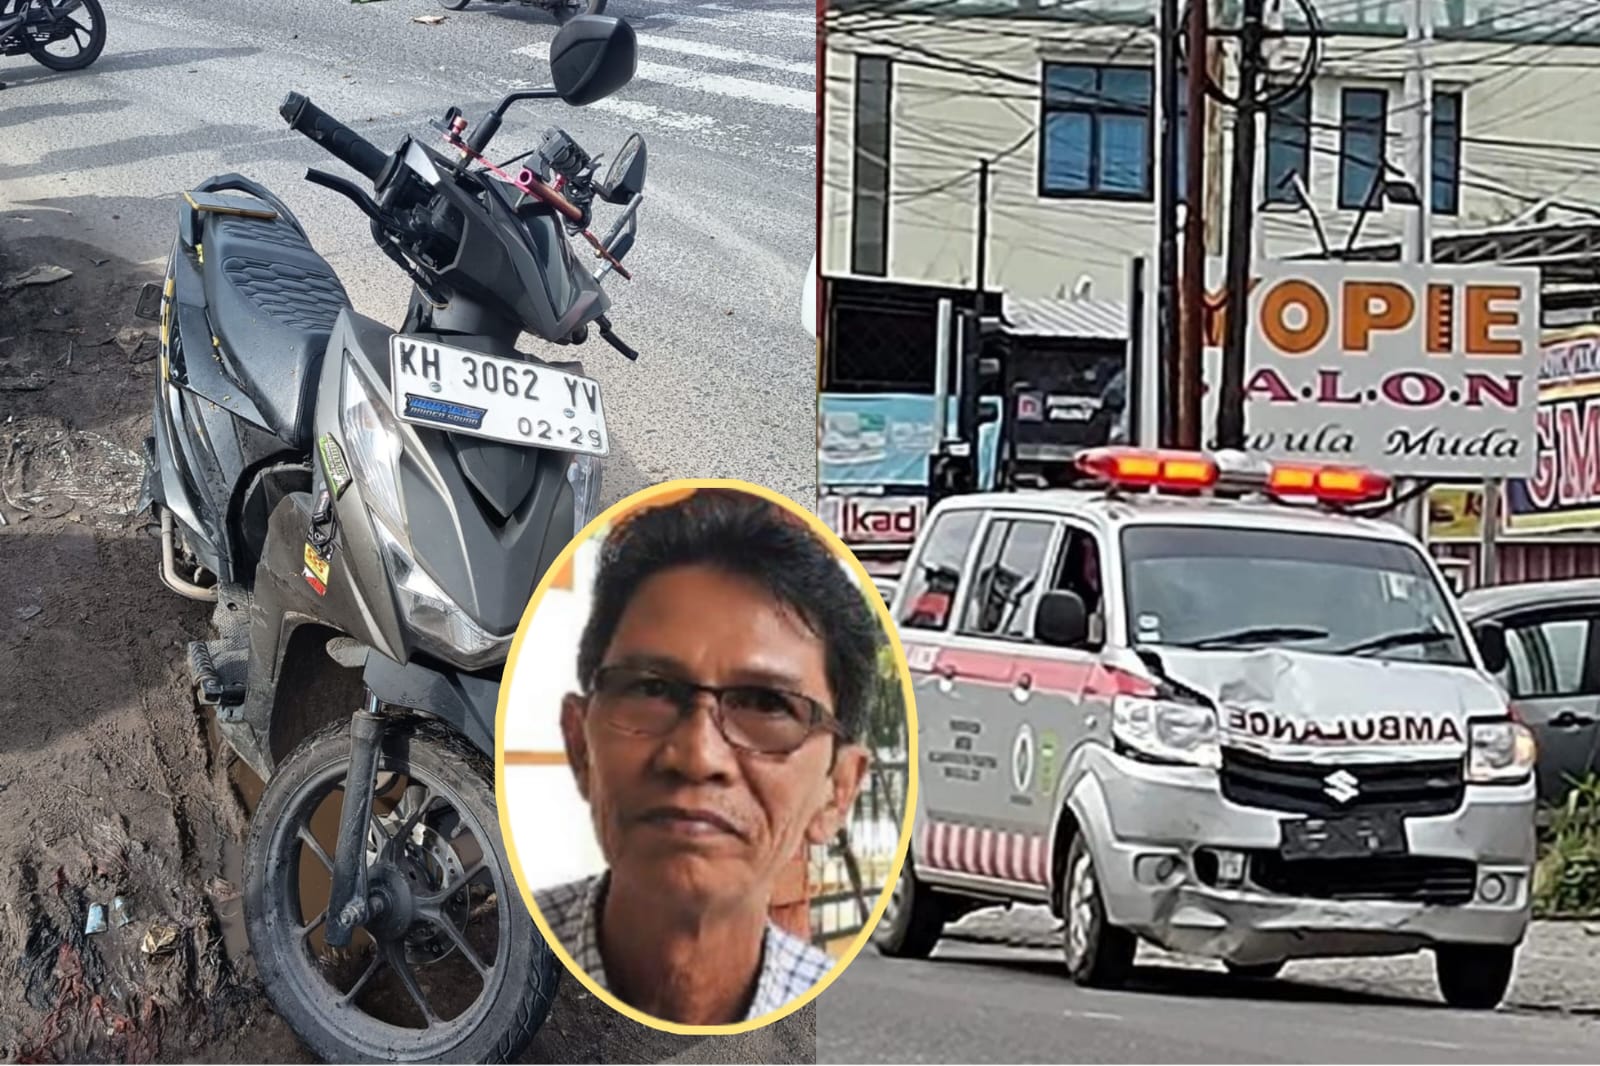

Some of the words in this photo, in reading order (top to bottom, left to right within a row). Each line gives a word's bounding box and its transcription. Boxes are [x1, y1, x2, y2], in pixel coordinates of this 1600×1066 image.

[400, 342, 441, 381] KH
[461, 356, 539, 401] 3062
[564, 376, 597, 413] YV
[1206, 423, 1354, 453] wula
[1386, 426, 1520, 458] Muda
